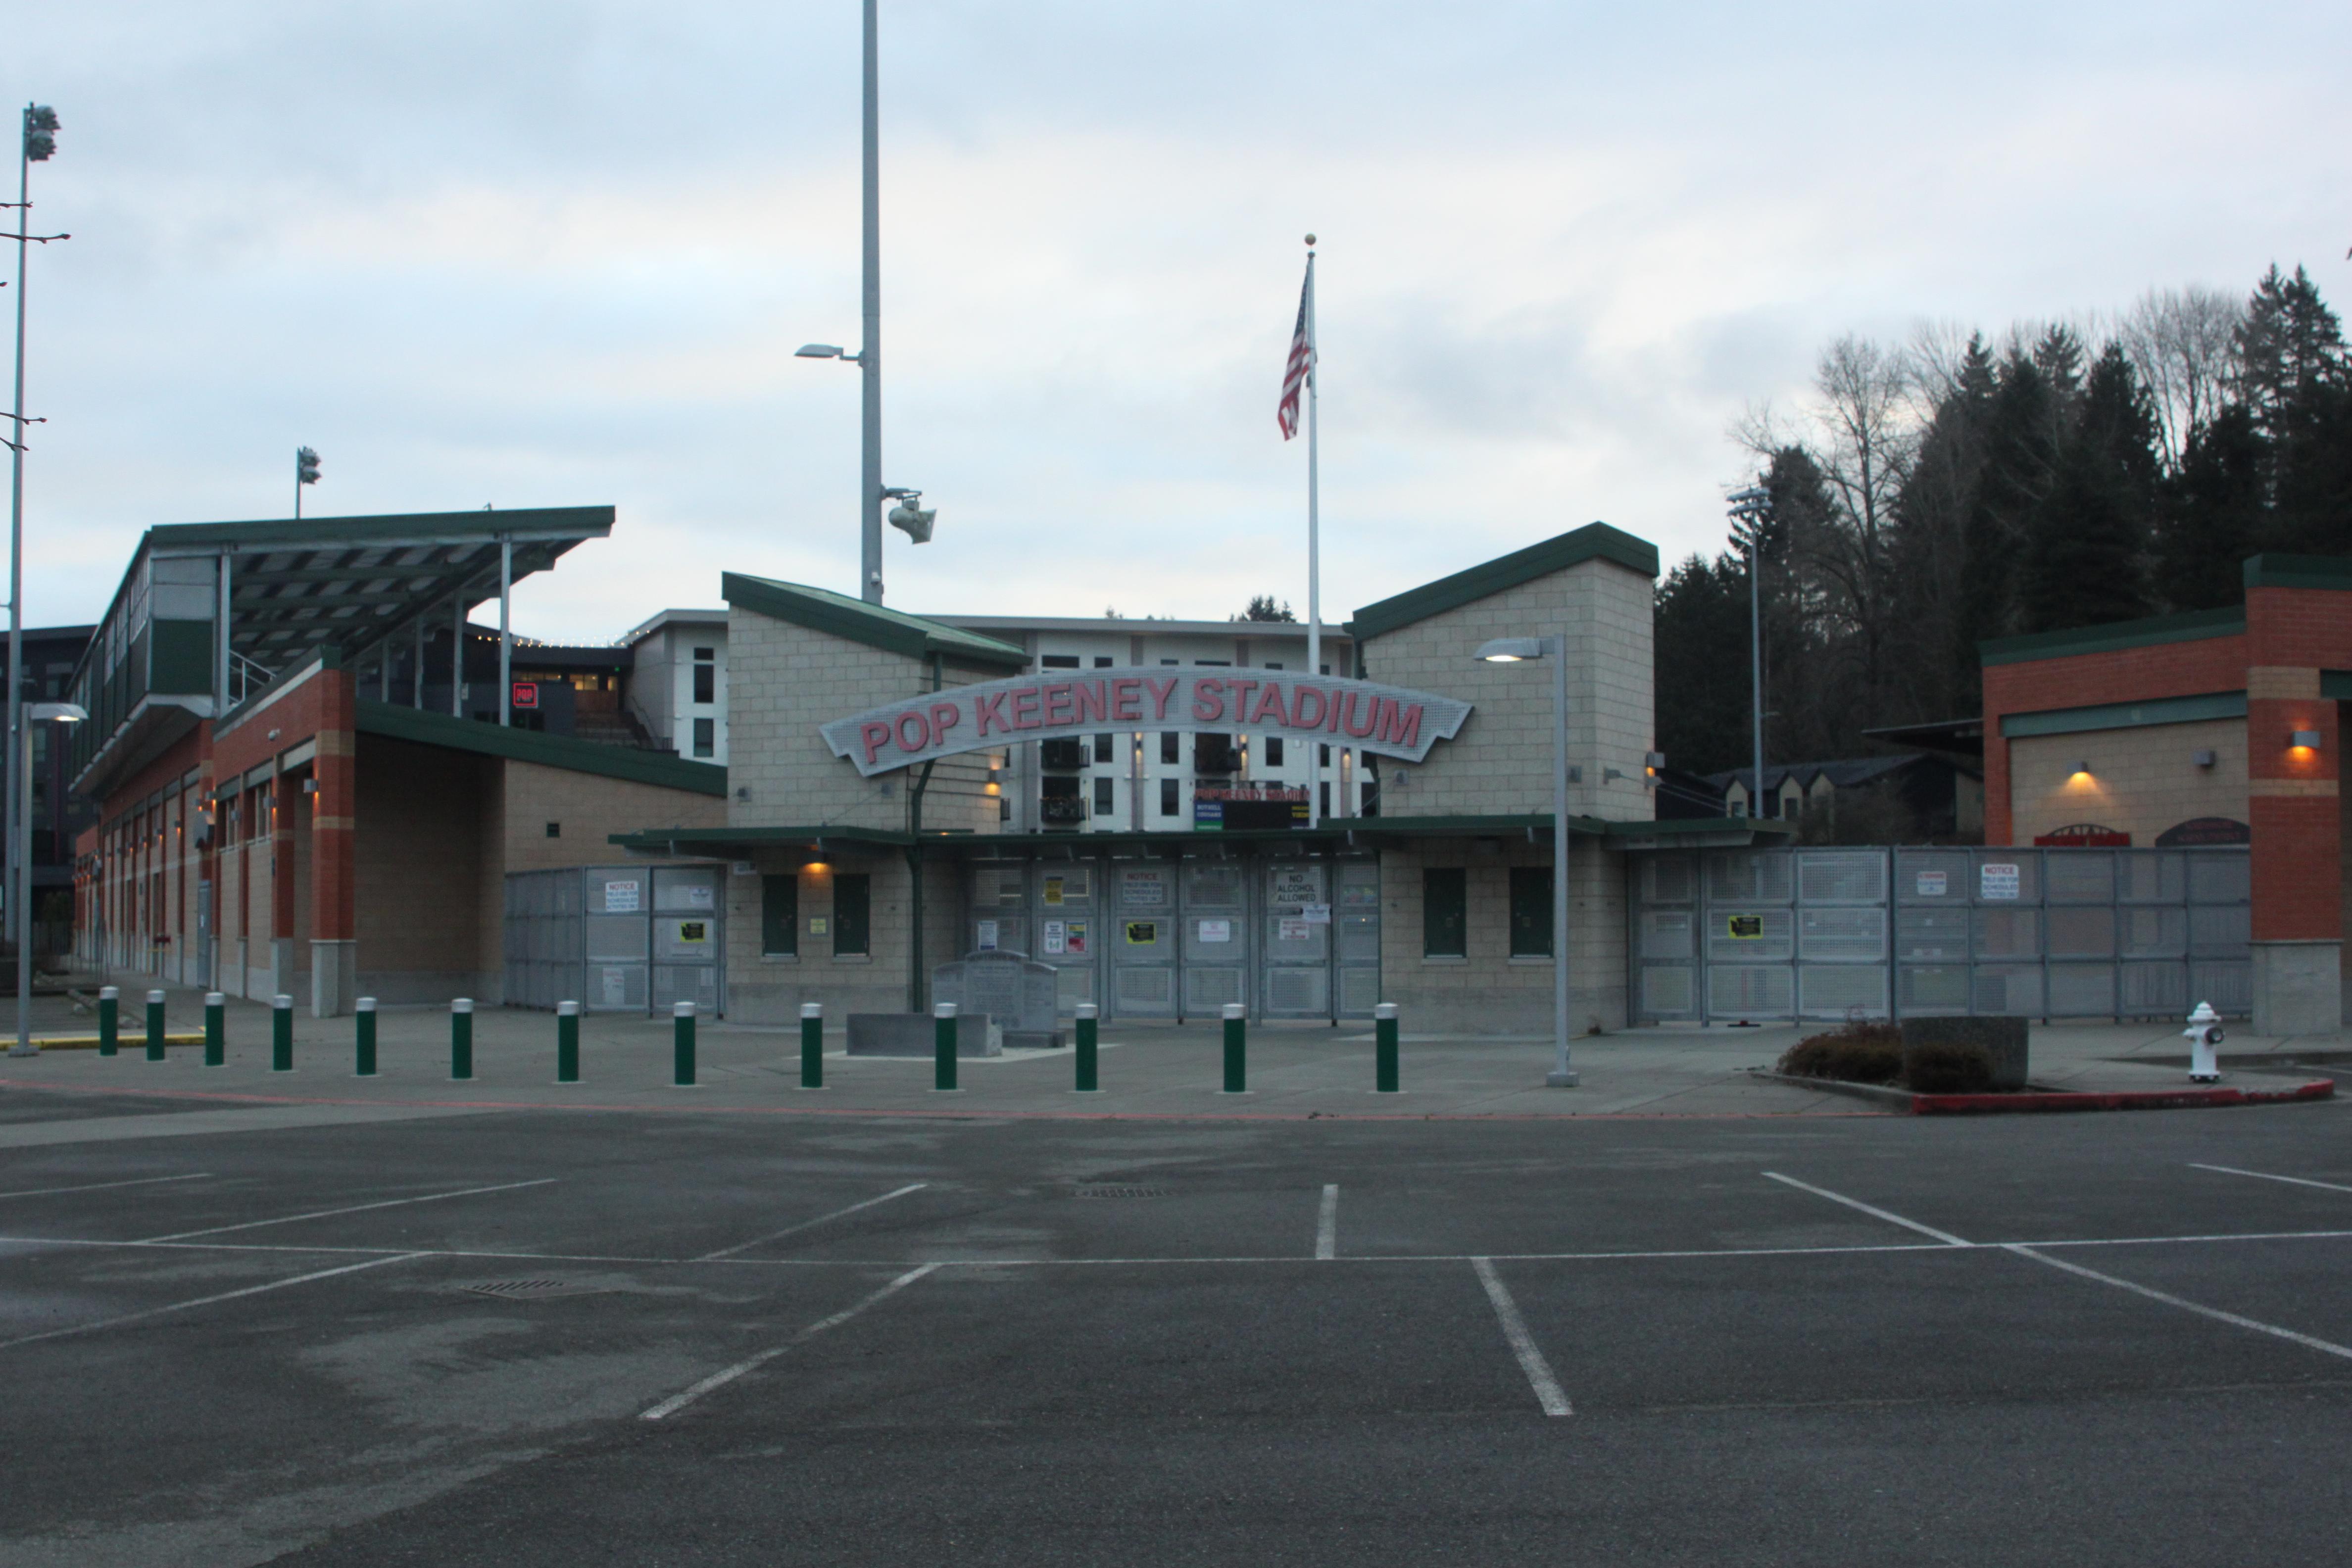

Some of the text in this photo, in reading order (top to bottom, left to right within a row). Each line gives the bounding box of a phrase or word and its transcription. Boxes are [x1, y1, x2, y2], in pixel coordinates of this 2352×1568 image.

[516, 688, 532, 700] POP
[860, 678, 1423, 764] POP KEENEY STADIUM
[1985, 866, 2014, 875] NOTICE
[1277, 884, 1315, 892] ALCOHOL
[1278, 893, 1316, 902] ALLOWED
